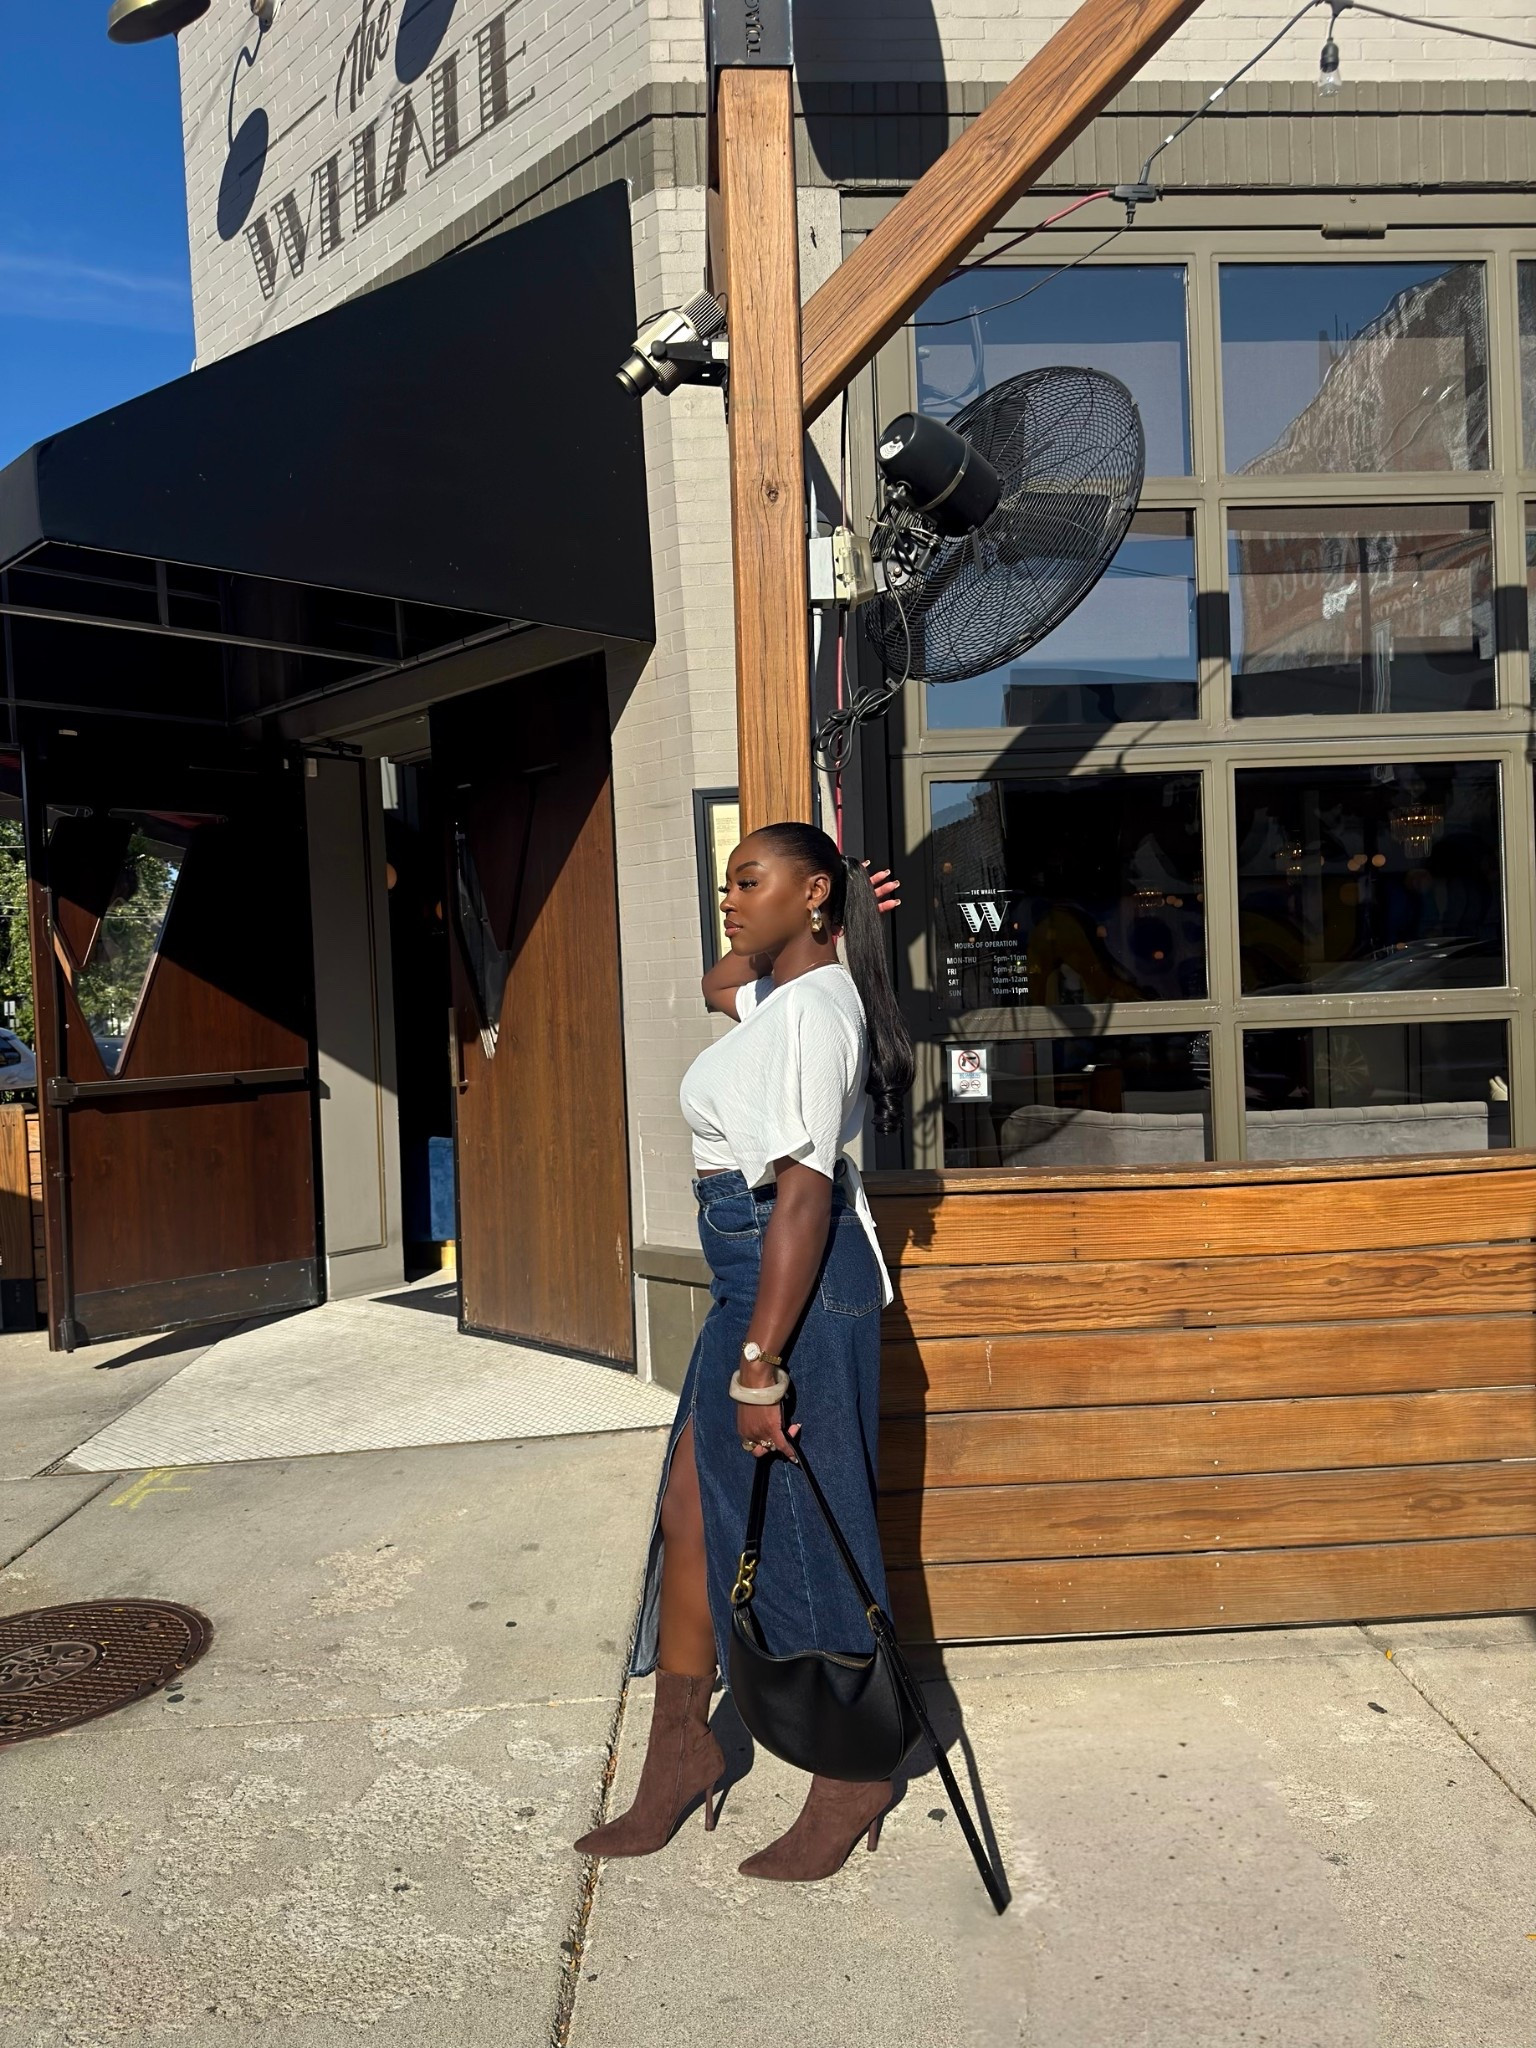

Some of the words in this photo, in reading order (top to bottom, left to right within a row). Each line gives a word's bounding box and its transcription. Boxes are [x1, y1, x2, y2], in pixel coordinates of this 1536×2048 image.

[336, 0, 392, 120] The
[242, 0, 536, 301] WHALE
[957, 900, 1011, 933] W
[954, 942, 975, 950] HOURS
[975, 941, 984, 949] OF
[985, 940, 1018, 948] OPERATION
[947, 956, 977, 965] MON-THU
[993, 954, 1027, 964] 5pm-11pm
[992, 975, 1028, 984] 10am-12am
[949, 989, 962, 997] SUN
[992, 986, 1029, 996] 10am-11pm
